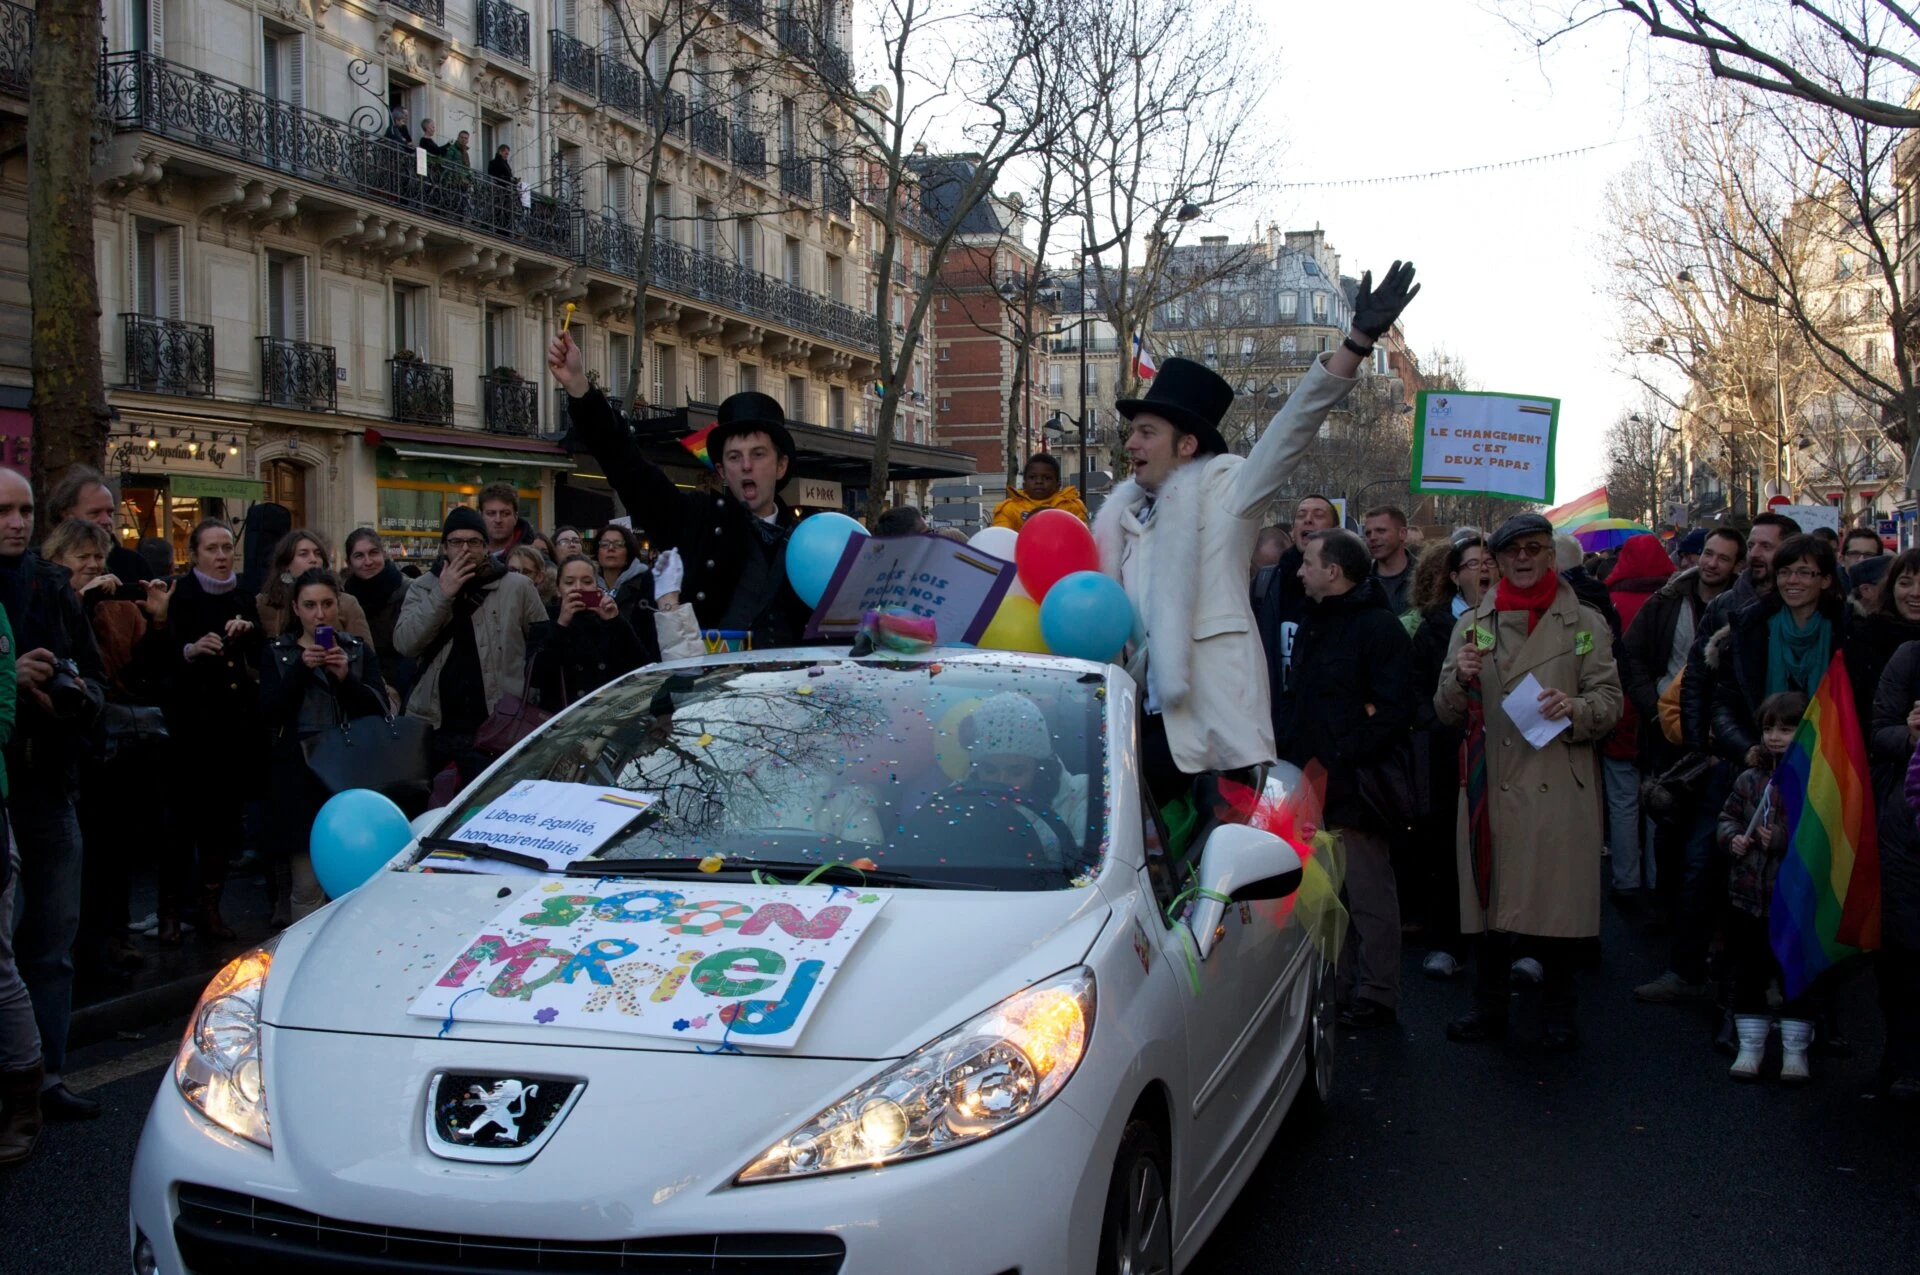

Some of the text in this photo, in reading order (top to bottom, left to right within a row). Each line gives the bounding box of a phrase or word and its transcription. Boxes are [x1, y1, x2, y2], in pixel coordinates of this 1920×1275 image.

[1430, 427, 1448, 437] LE
[1472, 443, 1508, 454] C'EST
[1444, 455, 1531, 470] DEUX PAPAS
[806, 485, 815, 500] LE
[876, 570, 950, 589] DES LOIS
[863, 585, 947, 605] POUR NOS
[484, 808, 597, 837] Liberté, égalité,
[458, 827, 582, 856] homoparentalité
[519, 889, 852, 939] SOON
